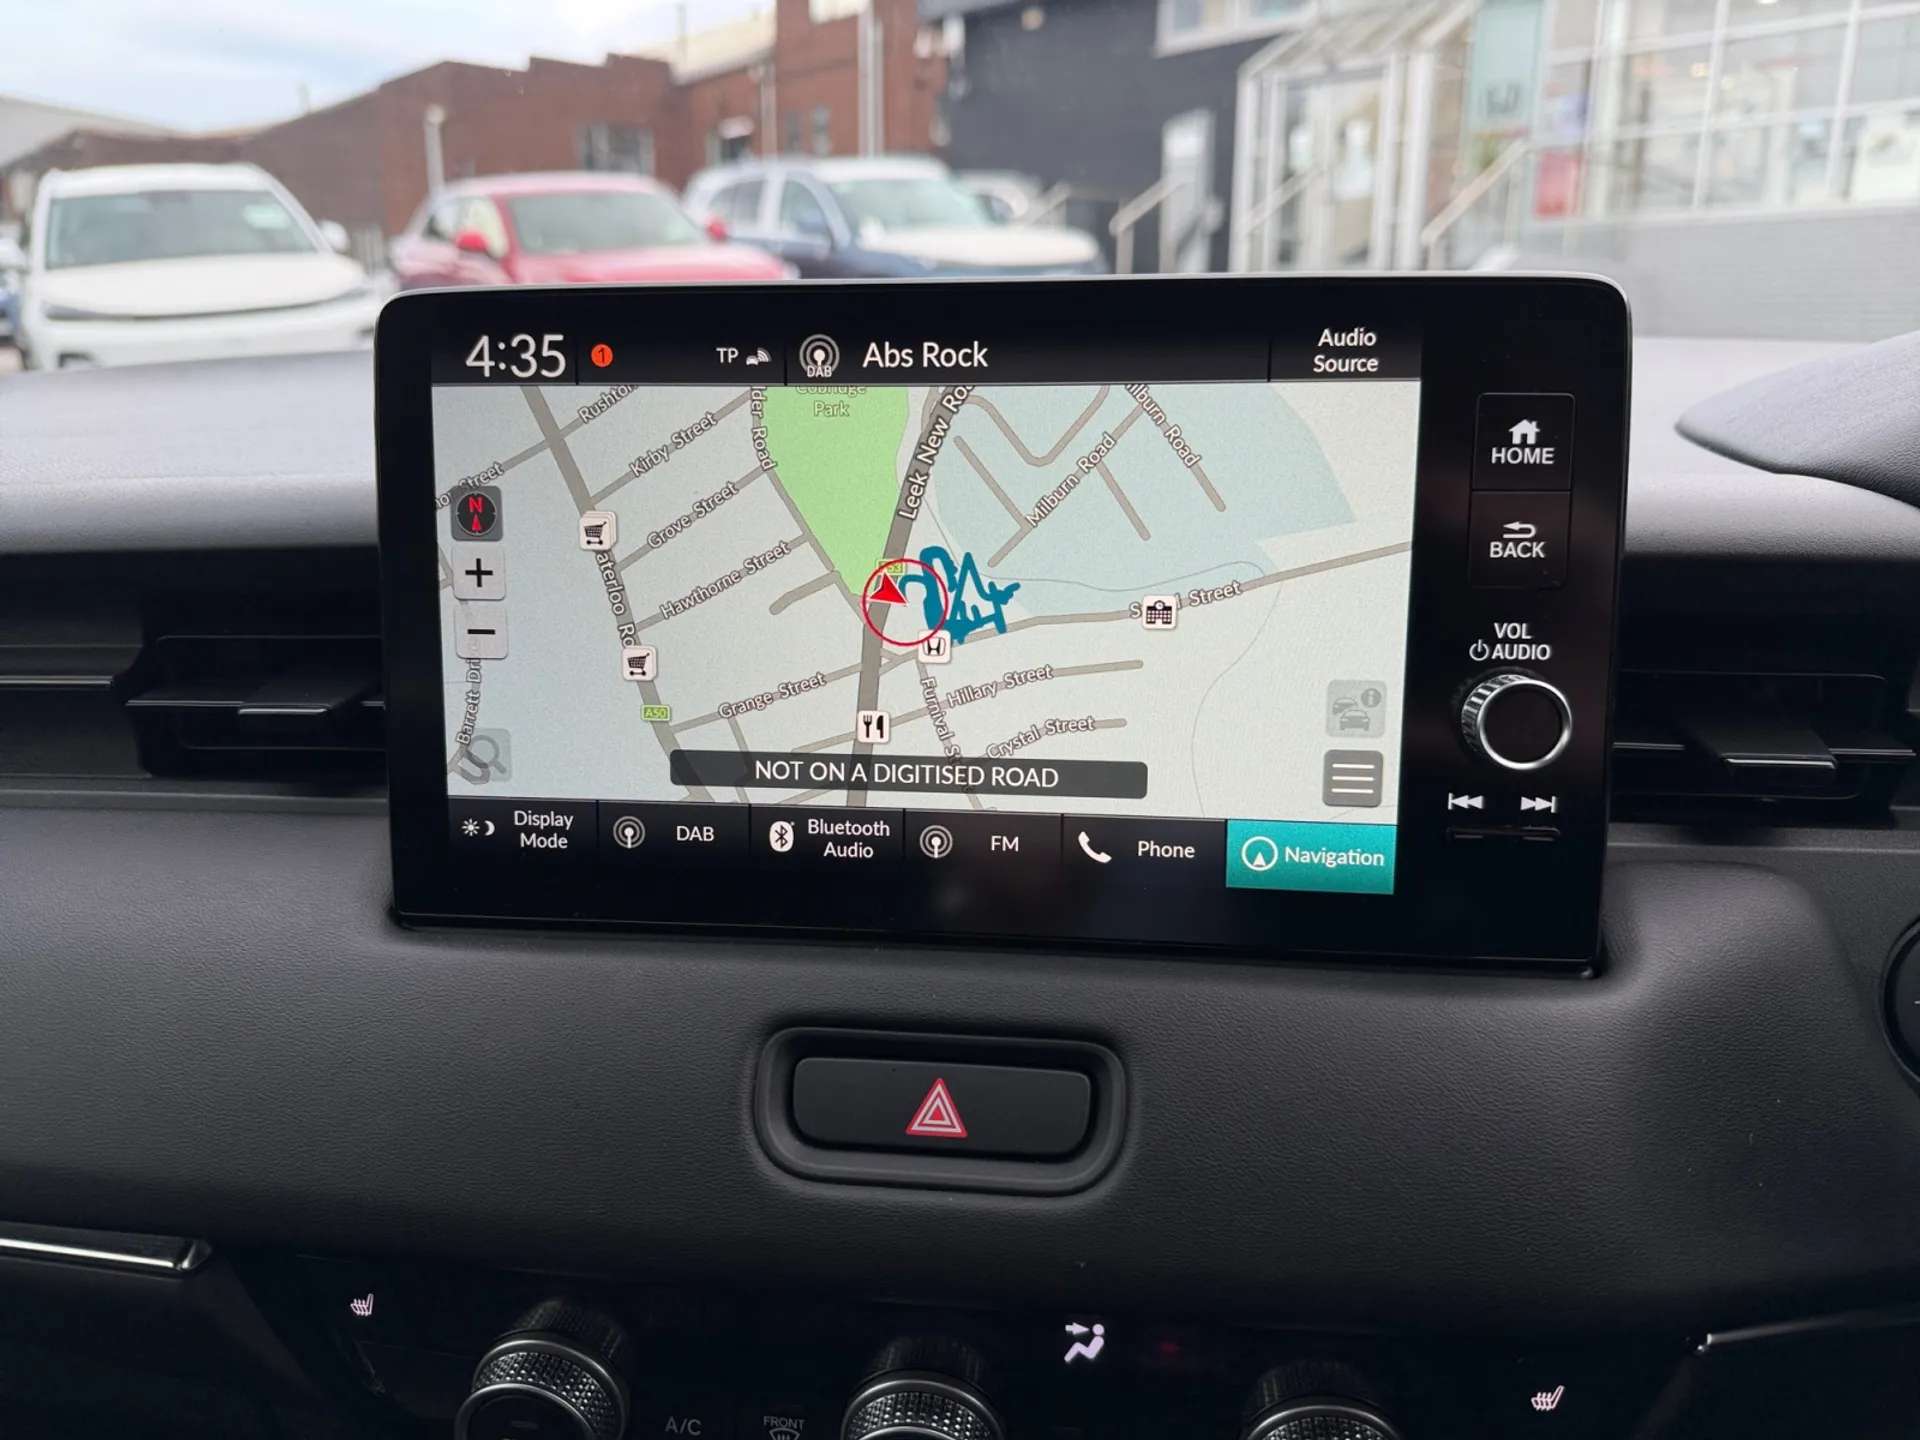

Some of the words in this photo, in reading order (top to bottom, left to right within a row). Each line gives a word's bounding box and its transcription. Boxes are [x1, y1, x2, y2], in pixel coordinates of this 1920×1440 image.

[1318, 328, 1377, 347] Audio
[465, 333, 567, 378] 4:35
[716, 347, 739, 364] TP
[862, 341, 914, 369] Abs
[922, 340, 989, 369] Rock
[1313, 355, 1379, 373] Source
[806, 365, 833, 378] DAB
[813, 400, 850, 418] Park
[1125, 384, 1167, 426] ilburn
[1164, 424, 1202, 469] Road
[628, 444, 670, 478] Kirby
[671, 411, 718, 450] Street
[751, 426, 778, 471] Road
[1490, 447, 1556, 465] HOME
[897, 469, 929, 521] Leek
[916, 416, 949, 465] New
[1026, 473, 1080, 528] Milburn
[1076, 430, 1117, 474] Road
[468, 496, 484, 513] N
[647, 513, 692, 549] Grove
[692, 481, 739, 519] Street
[1488, 541, 1546, 559] BACK
[596, 551, 626, 616] aterloo
[660, 569, 742, 620] Hawthorne
[743, 541, 792, 577] Street
[1187, 579, 1242, 608] Street
[1493, 622, 1533, 640] VOL
[1491, 643, 1552, 661] AUDIO
[718, 693, 774, 720] Grange
[777, 672, 827, 699] Street
[946, 682, 998, 709] Hillary
[1003, 664, 1054, 690] Street
[455, 689, 482, 745] Barrett
[921, 677, 955, 742] Furnival
[986, 724, 1041, 760] Crystal
[1044, 715, 1097, 737] Street
[754, 759, 803, 782] NOT
[809, 761, 846, 783] ON
[851, 763, 868, 783] A
[874, 763, 985, 788] DIGITISED
[991, 766, 1059, 789] ROAD
[513, 809, 575, 831] Display
[807, 817, 891, 838] Bluetooth
[519, 832, 569, 850] Mode
[675, 825, 715, 843] DAB
[990, 835, 1020, 853] FM
[823, 841, 874, 859] Audio
[1137, 840, 1196, 859] Phone
[1285, 846, 1386, 868] Navigation
[664, 1415, 702, 1437] A/C
[763, 1415, 805, 1431] FRONT
